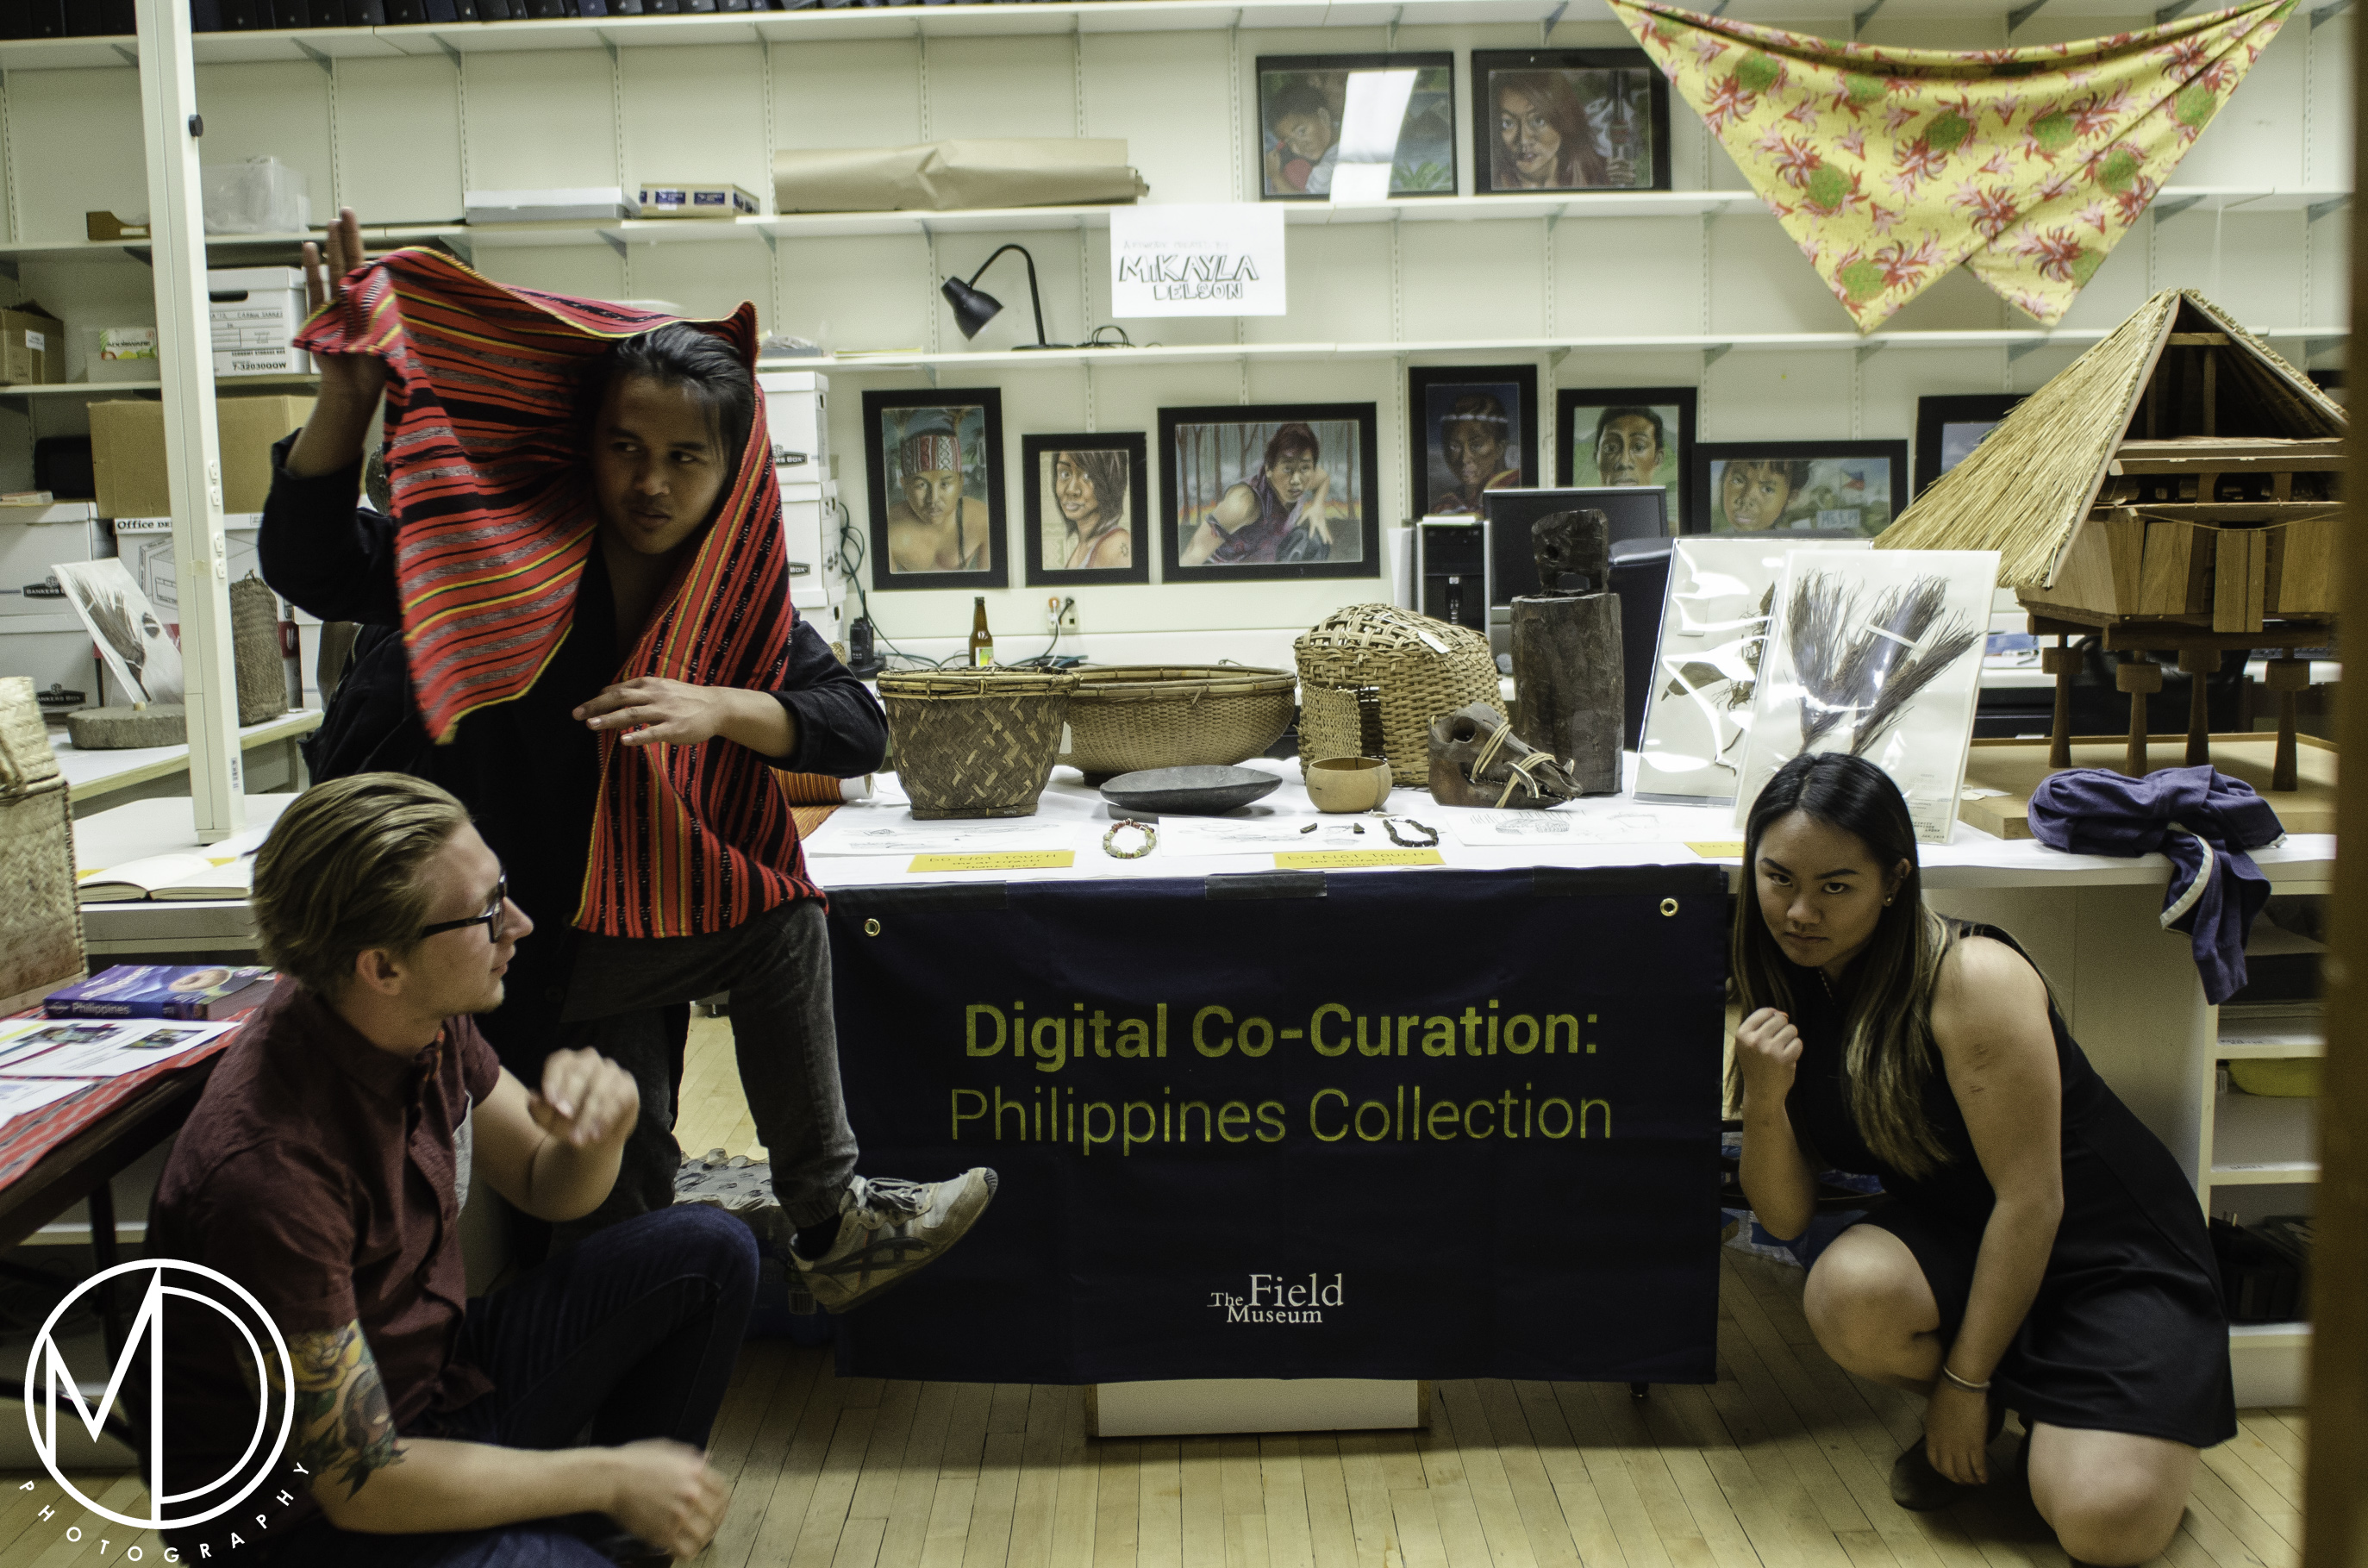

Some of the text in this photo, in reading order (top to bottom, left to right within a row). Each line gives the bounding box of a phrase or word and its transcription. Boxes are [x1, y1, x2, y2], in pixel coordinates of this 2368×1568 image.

[117, 520, 154, 529] Office
[72, 1001, 132, 1015] Philippines
[965, 999, 1598, 1072] Digital Co-Curation:
[951, 1082, 1612, 1157] Philippines Collection
[1210, 1272, 1345, 1308] The Field
[1226, 1305, 1323, 1324] Museum
